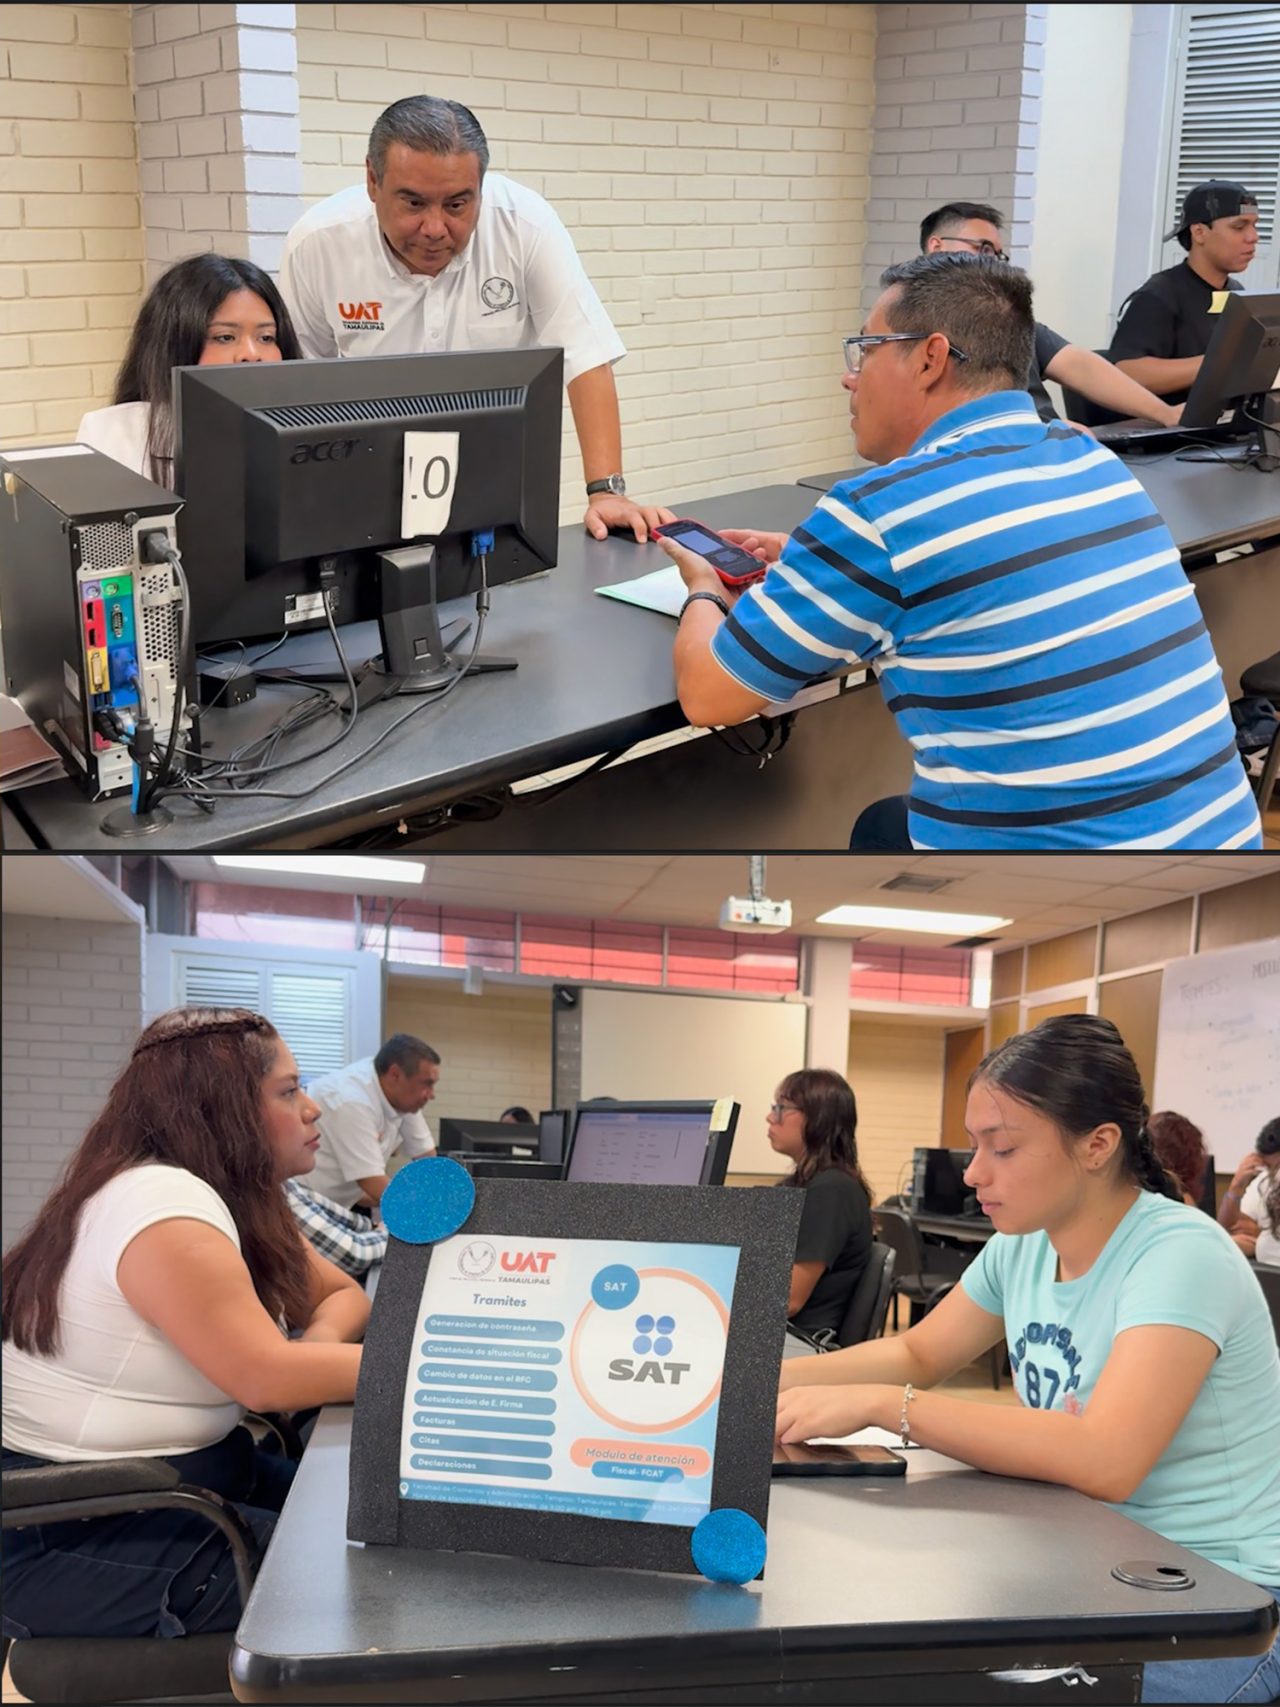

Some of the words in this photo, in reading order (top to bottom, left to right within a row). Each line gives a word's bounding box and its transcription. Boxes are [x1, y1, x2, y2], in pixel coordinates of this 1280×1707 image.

[338, 302, 382, 321] UAT
[290, 438, 361, 465] acer
[500, 1250, 556, 1273] UAT
[498, 1276, 551, 1286] TAMAULIPAS
[603, 1281, 628, 1292] SAT
[473, 1293, 527, 1308] Tramites
[478, 1320, 489, 1330] de
[490, 1322, 537, 1333] contraseña
[427, 1344, 474, 1355] Constancia
[475, 1346, 486, 1356] de
[526, 1350, 550, 1360] fiscal
[423, 1369, 456, 1379] Cambio
[457, 1370, 467, 1379] de
[468, 1371, 493, 1382] datos
[494, 1374, 505, 1382] en
[505, 1374, 514, 1383] el
[515, 1375, 532, 1384] RFC
[607, 1358, 691, 1385] SAT
[1024, 1361, 1061, 1410] 87
[479, 1397, 490, 1407] de
[499, 1399, 524, 1409] Firma
[420, 1415, 456, 1426] Facturas
[418, 1435, 440, 1445] Citas
[417, 1458, 477, 1470] Declaraciones
[585, 1447, 626, 1460] Modulo
[628, 1450, 642, 1461] de
[645, 1453, 696, 1466] atención
[641, 1467, 664, 1478] FCAT
